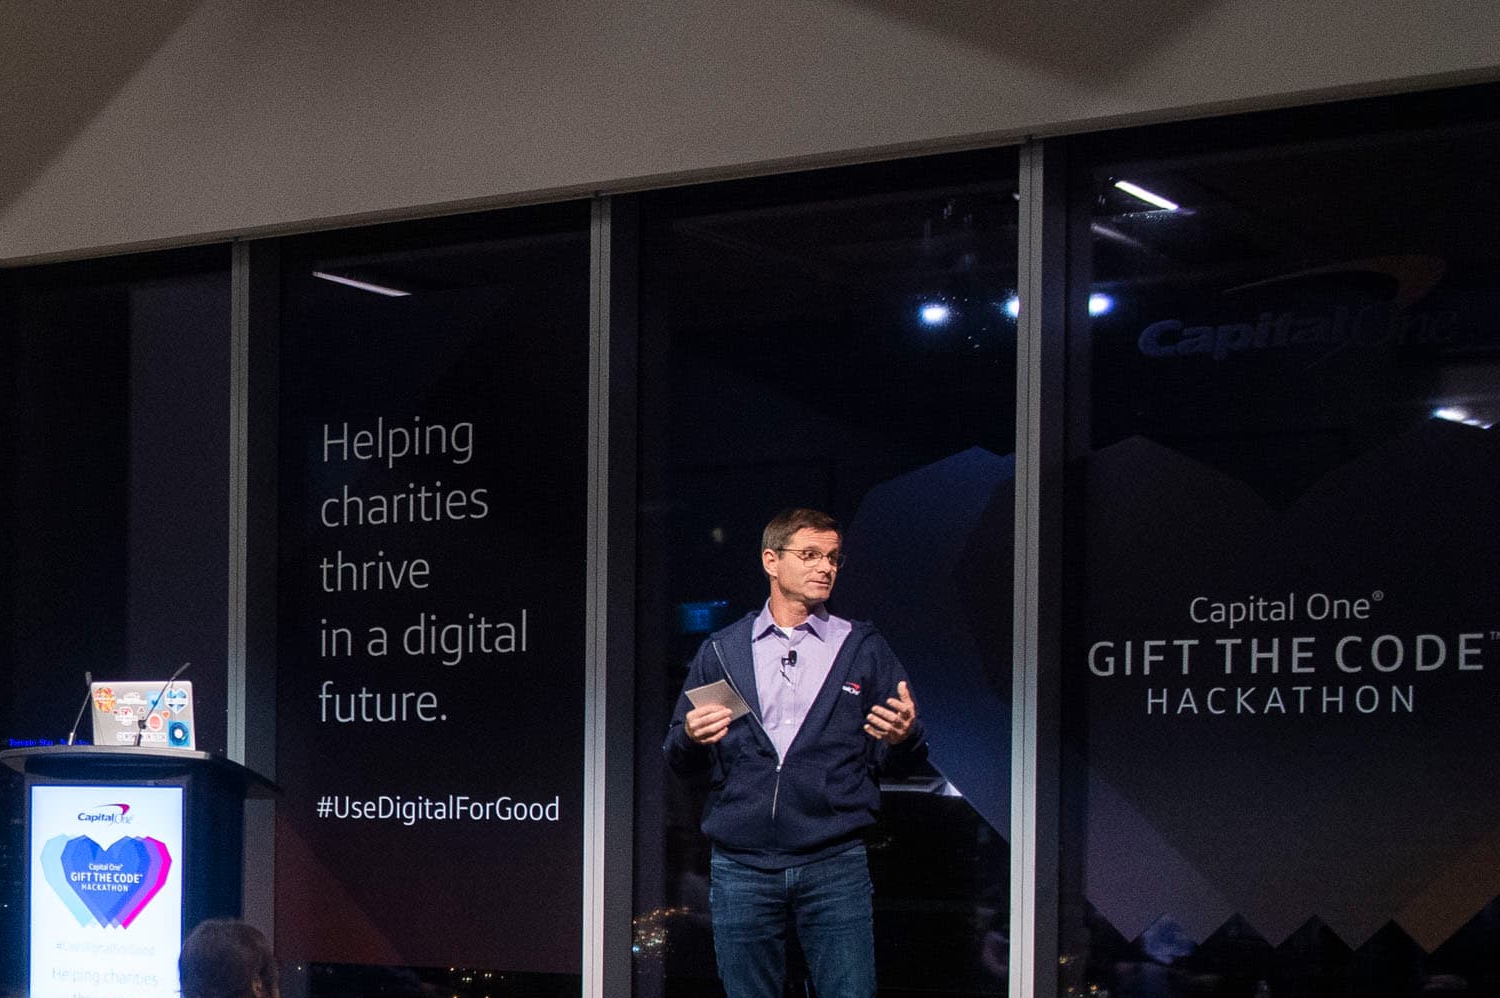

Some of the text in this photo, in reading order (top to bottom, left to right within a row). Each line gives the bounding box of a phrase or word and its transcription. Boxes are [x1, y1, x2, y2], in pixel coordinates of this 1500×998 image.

[323, 416, 474, 469] Helping
[320, 480, 489, 527] charities
[319, 550, 430, 592] thrive
[1189, 593, 1295, 629] Capital
[320, 608, 528, 666] in a digital
[1087, 633, 1484, 677] GIFT THE CODE
[318, 680, 447, 723] future.
[1146, 684, 1415, 715] HACKATHON
[316, 794, 560, 826] #UseDigitalForGood
[70, 872, 140, 884] GIFT THE CODE
[88, 863, 108, 871] Capital
[81, 883, 129, 892] HACKATHON
[51, 967, 159, 986] Helping charities
